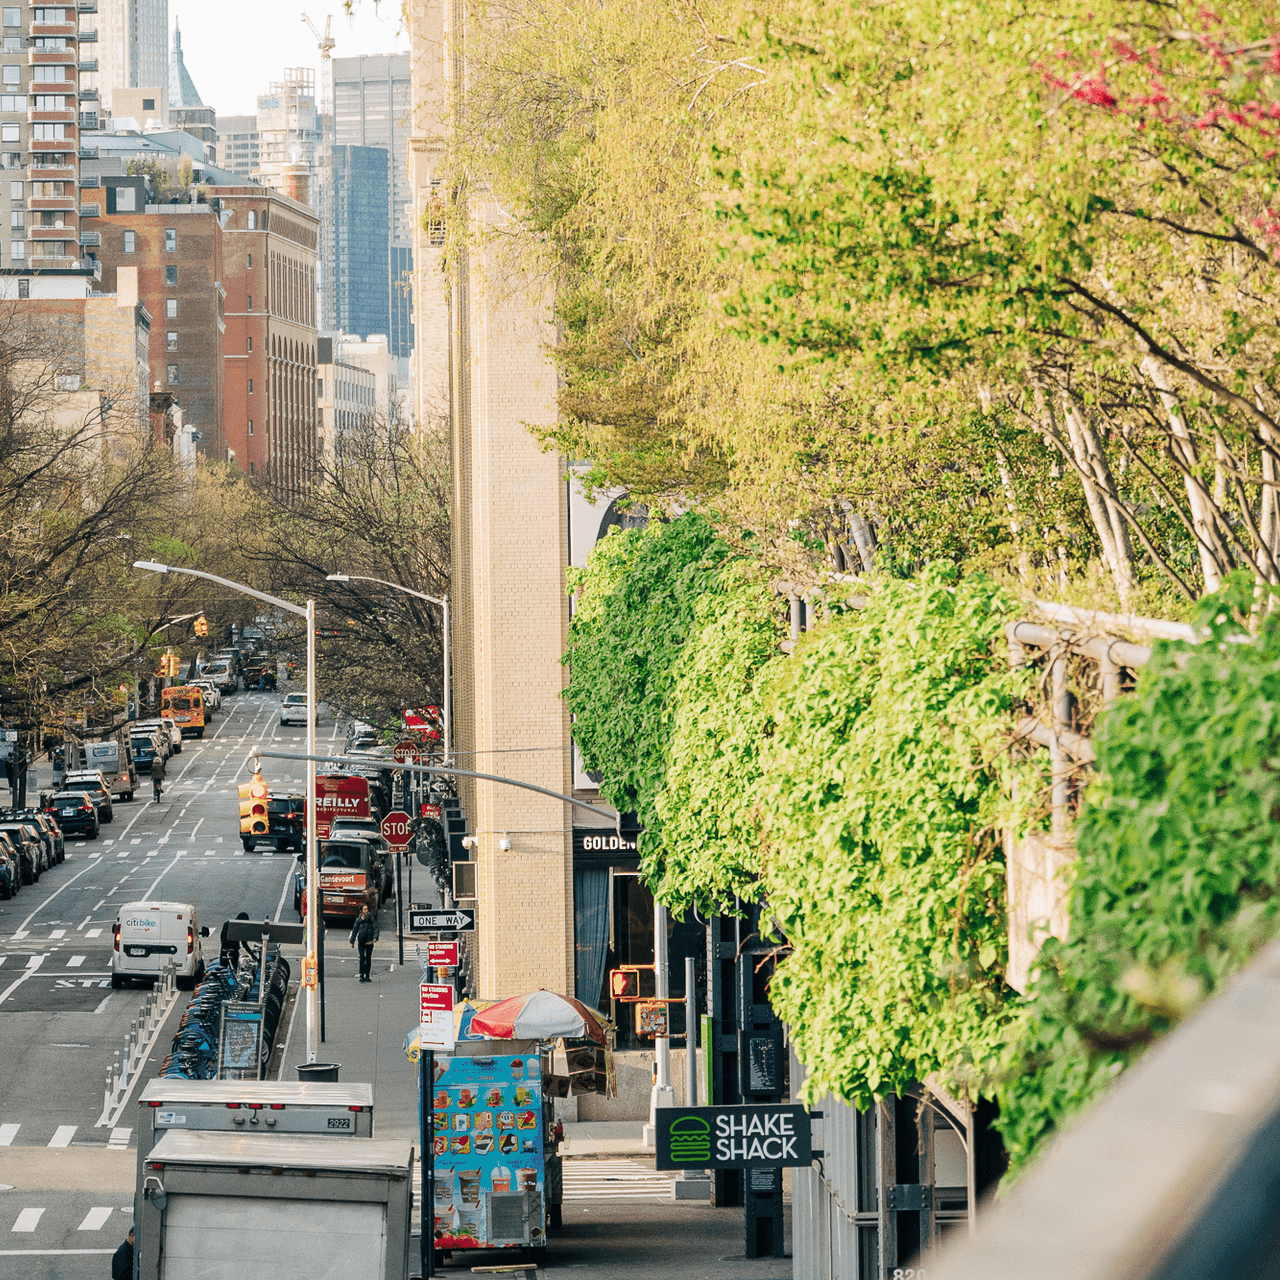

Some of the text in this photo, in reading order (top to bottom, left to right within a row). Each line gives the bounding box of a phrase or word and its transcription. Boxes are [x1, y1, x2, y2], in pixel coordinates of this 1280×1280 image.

[320, 875, 355, 883] Gansevoort
[418, 916, 465, 926] ONE WAY
[328, 1120, 350, 1128] 2922
[716, 1113, 795, 1137] SHAKE
[716, 1137, 798, 1161] SHACK
